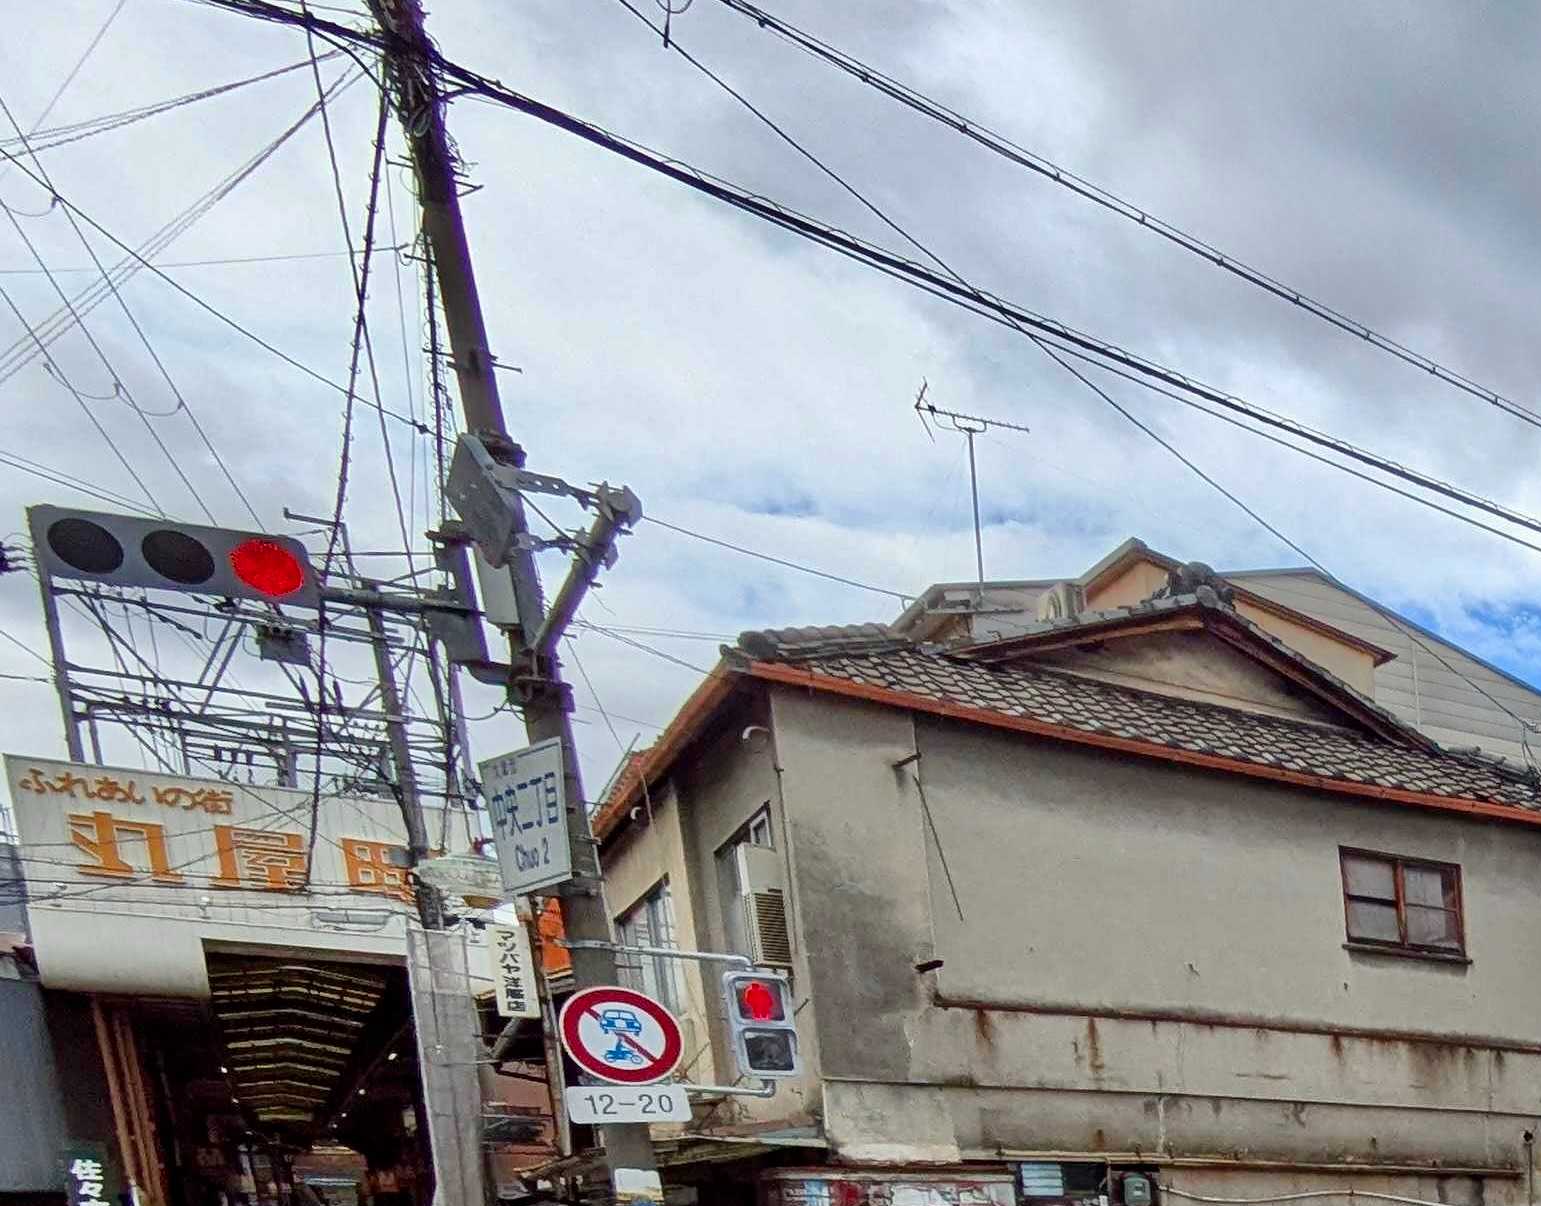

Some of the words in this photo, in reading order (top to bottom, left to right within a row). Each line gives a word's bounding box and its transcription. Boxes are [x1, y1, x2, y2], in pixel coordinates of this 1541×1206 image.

[20, 767, 234, 815] ふれあいの街
[492, 771, 559, 841] 中央二丁目
[514, 842, 540, 873] Chuo
[542, 836, 551, 865] 2
[584, 1093, 674, 1116] 12-20
